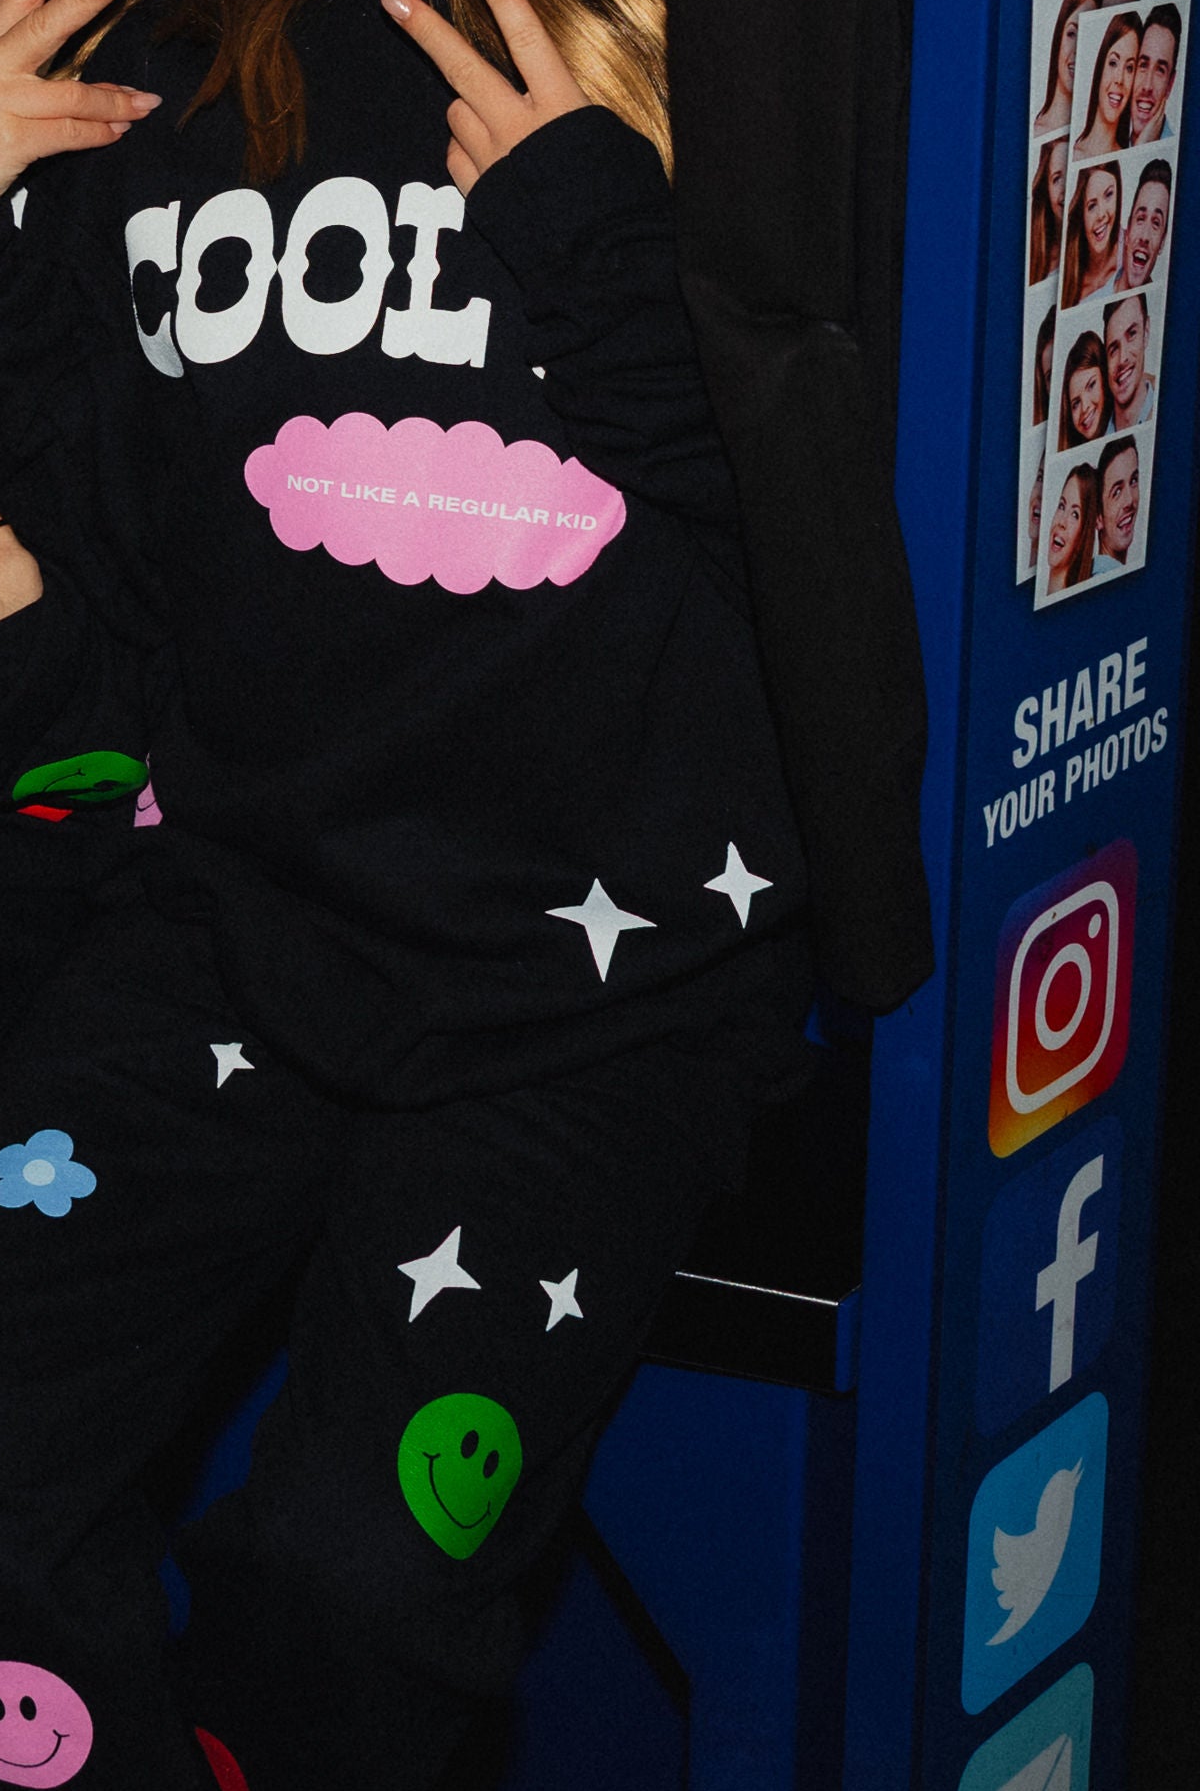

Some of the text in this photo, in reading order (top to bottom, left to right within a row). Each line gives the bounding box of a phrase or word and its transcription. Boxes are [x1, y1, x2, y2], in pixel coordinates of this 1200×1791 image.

[125, 176, 492, 378] COOL
[287, 474, 598, 531] NOT LIKE A REGULAR KID
[1012, 636, 1148, 769] SHARE
[983, 707, 1169, 849] YOUR PHOTOS
